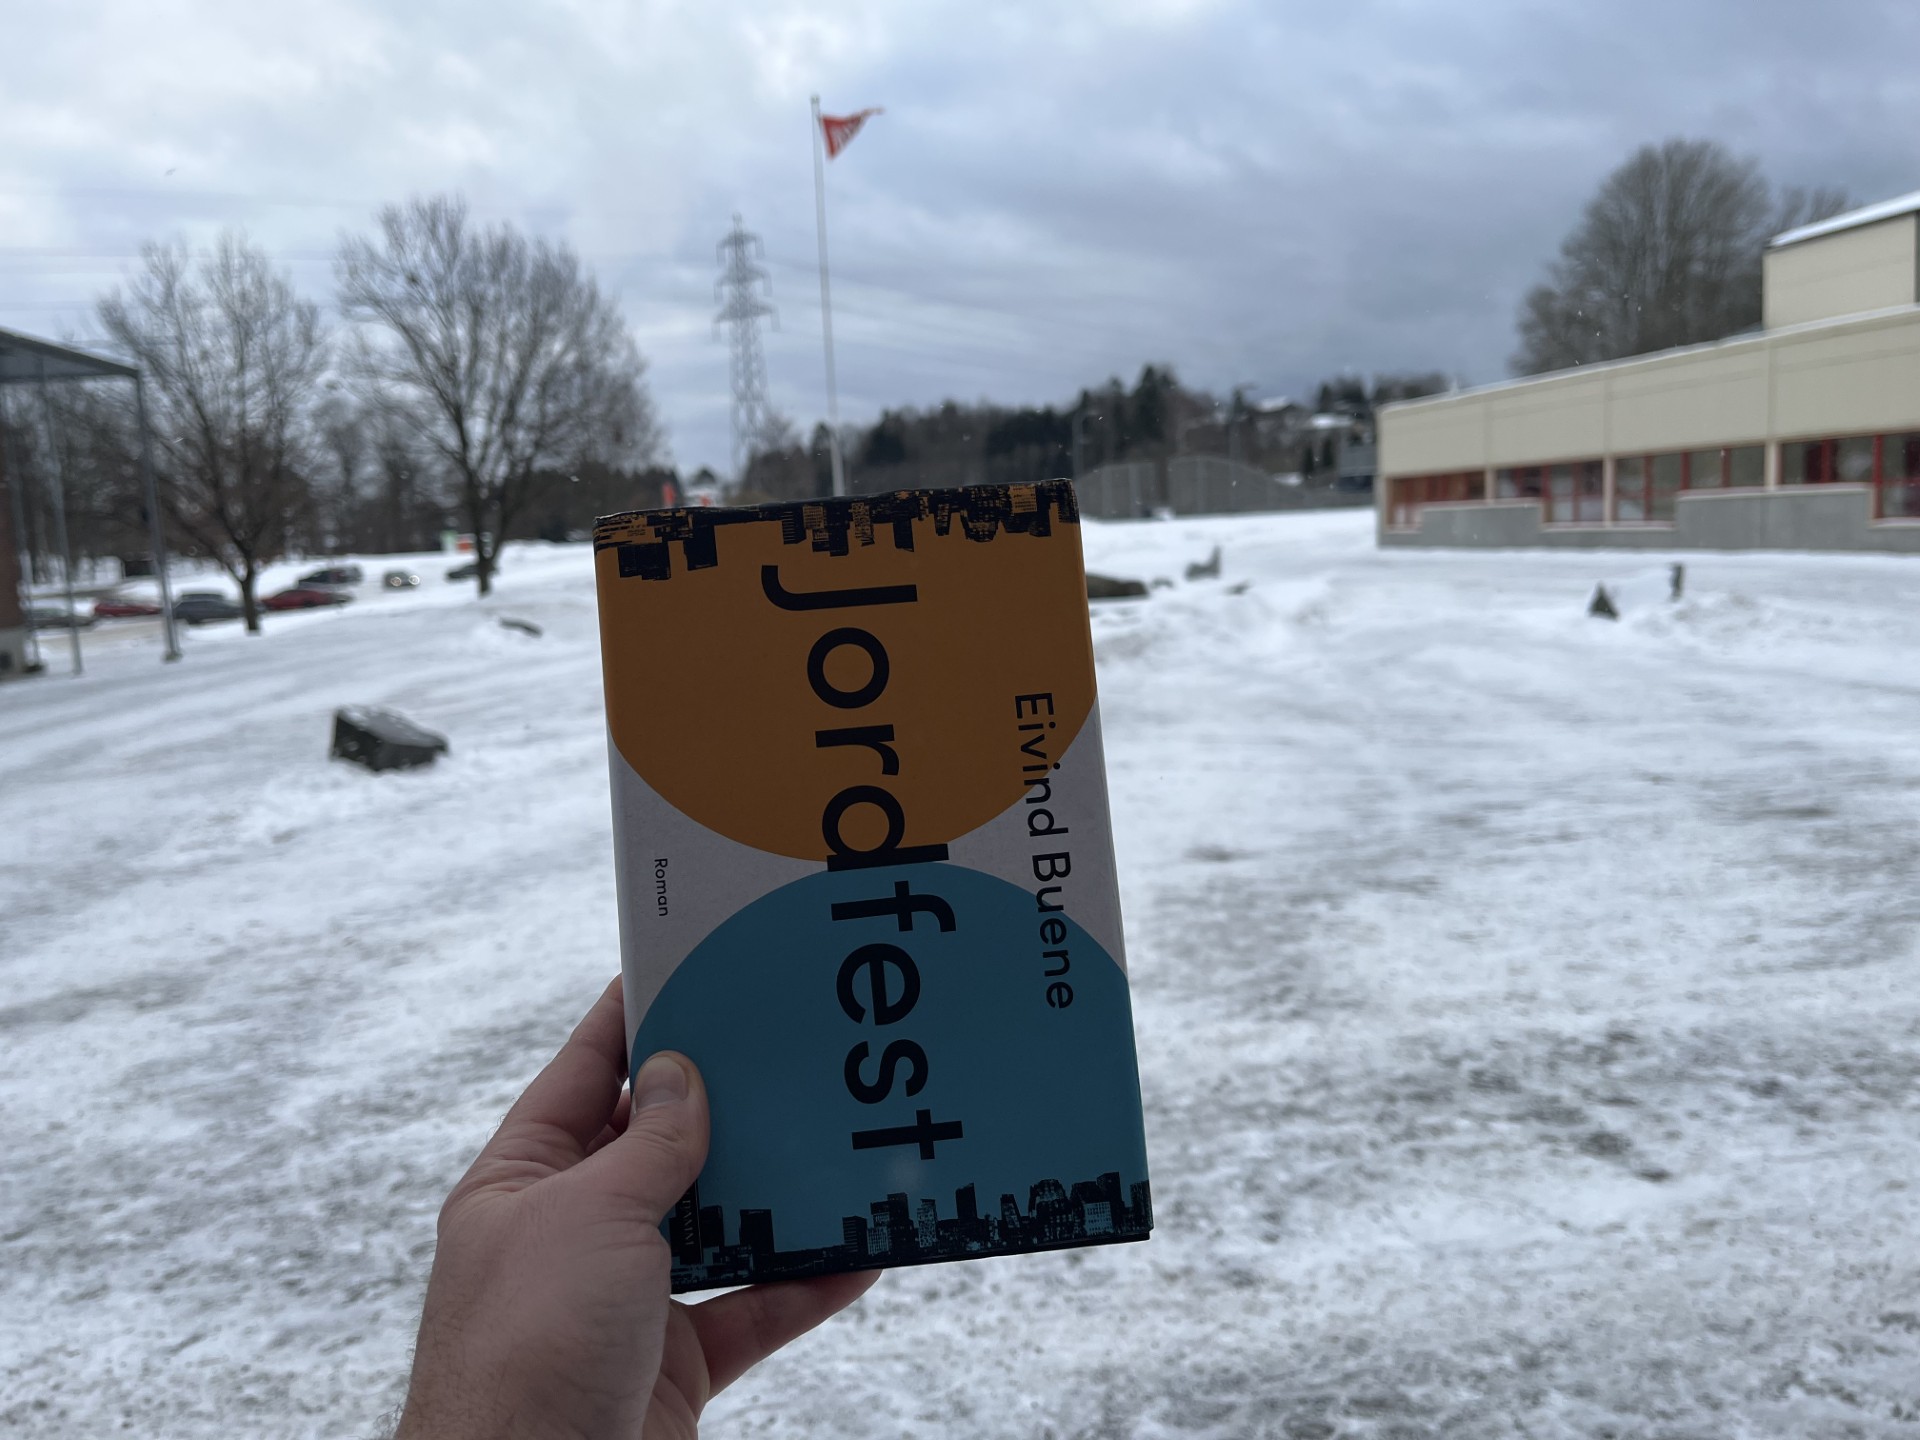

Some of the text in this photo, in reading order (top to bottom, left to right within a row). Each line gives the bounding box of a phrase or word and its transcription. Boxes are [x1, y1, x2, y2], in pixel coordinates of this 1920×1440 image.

[654, 858, 669, 917] Roman
[761, 565, 964, 1160] Jordfest
[1014, 692, 1074, 1009] Eivind Buene
[682, 1199, 694, 1246] DAMM
